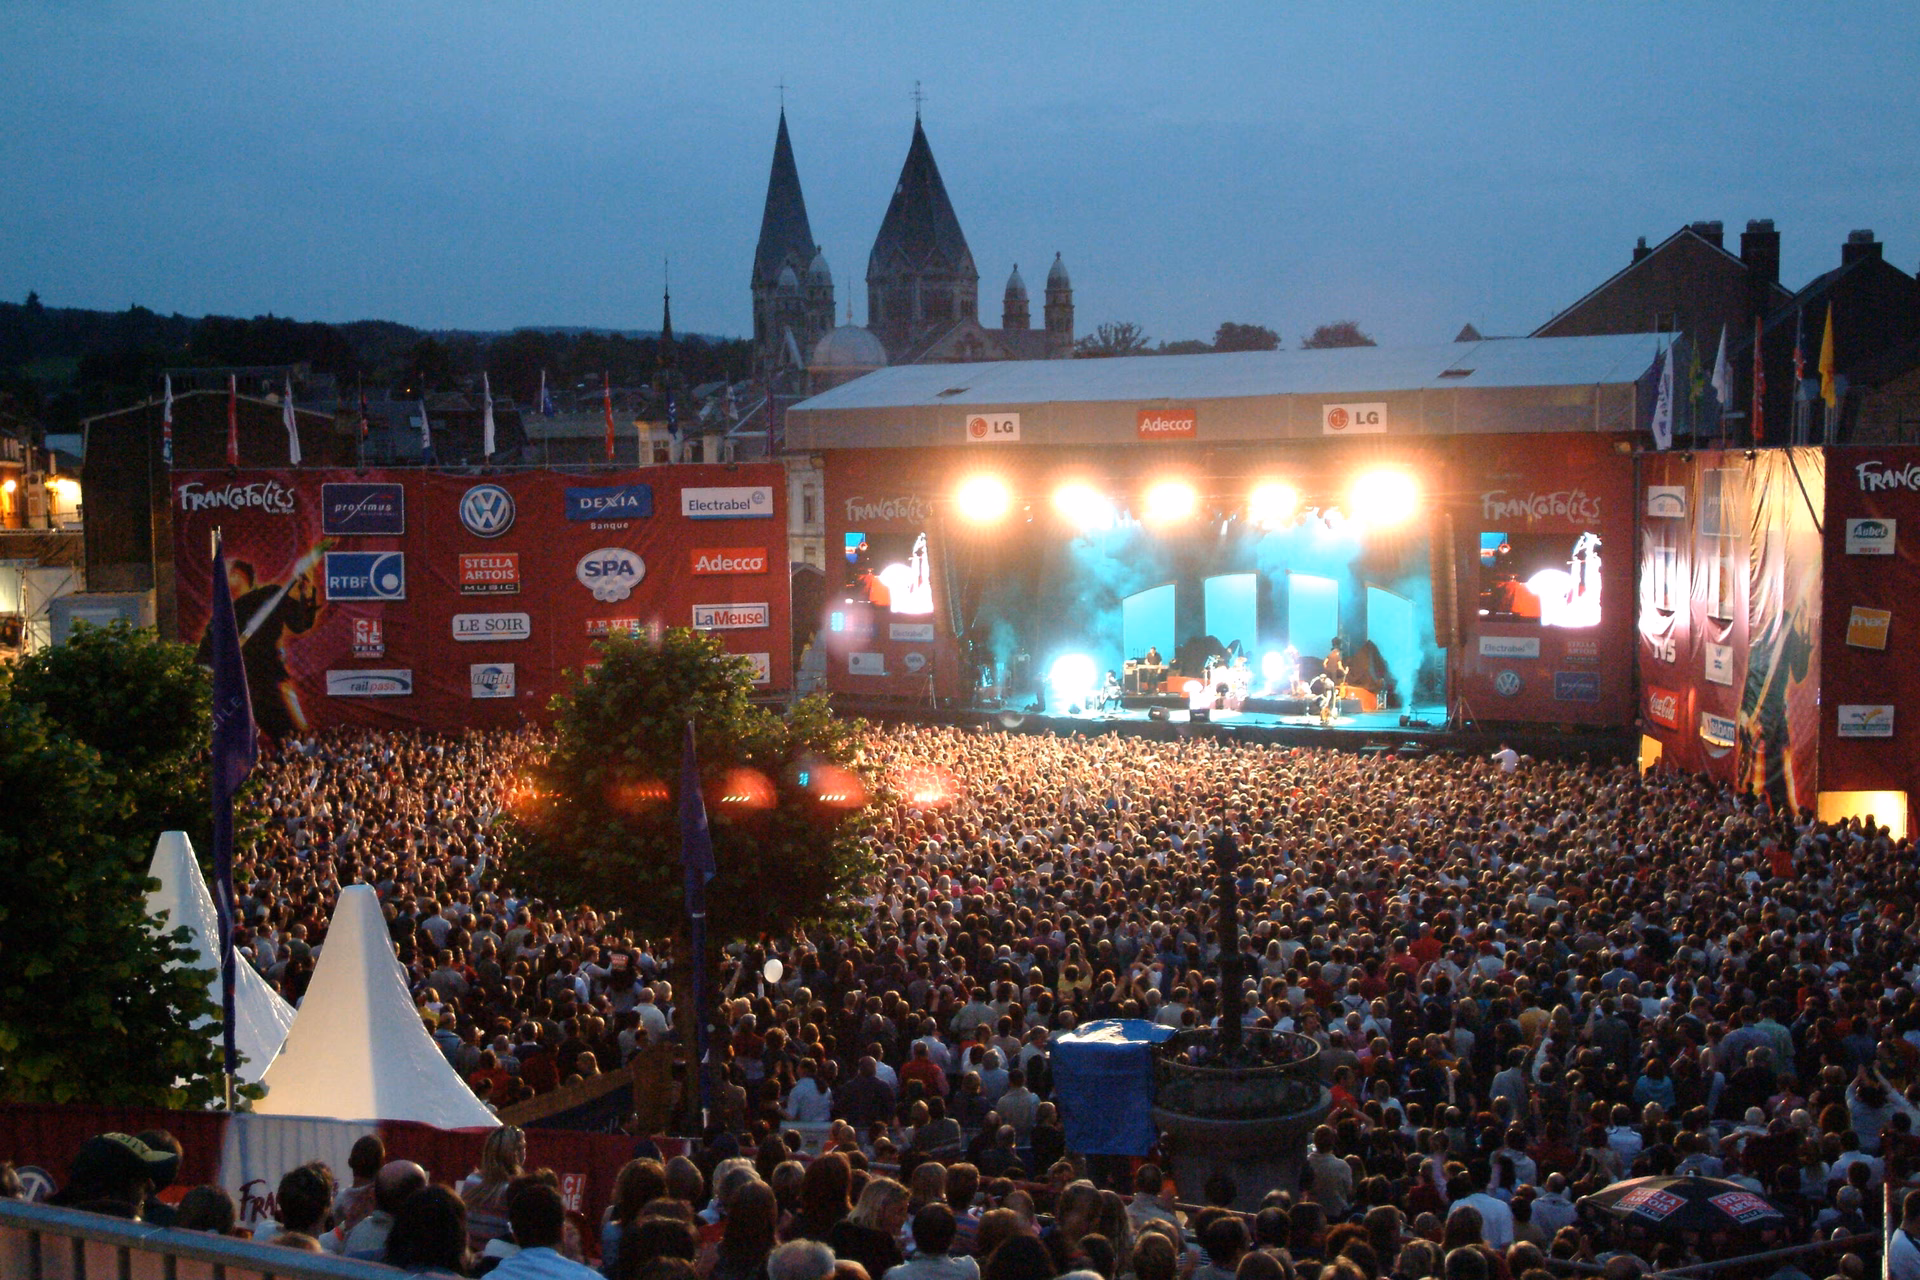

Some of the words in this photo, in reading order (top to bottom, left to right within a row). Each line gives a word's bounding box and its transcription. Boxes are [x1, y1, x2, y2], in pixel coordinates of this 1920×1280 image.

[1140, 417, 1194, 432] Adecco
[1356, 411, 1379, 425] LG
[994, 421, 1014, 433] LG
[335, 503, 392, 513] proximus
[580, 493, 638, 512] DEXIA
[689, 498, 751, 511] Electrabel
[590, 522, 629, 530] Banque
[464, 559, 513, 569] STELLA
[584, 560, 634, 577] SPA
[694, 554, 764, 572] Adecco
[465, 570, 514, 580] ARTOIS
[329, 576, 369, 589] RTBF
[459, 619, 480, 632] LE
[485, 618, 524, 631] SOIR
